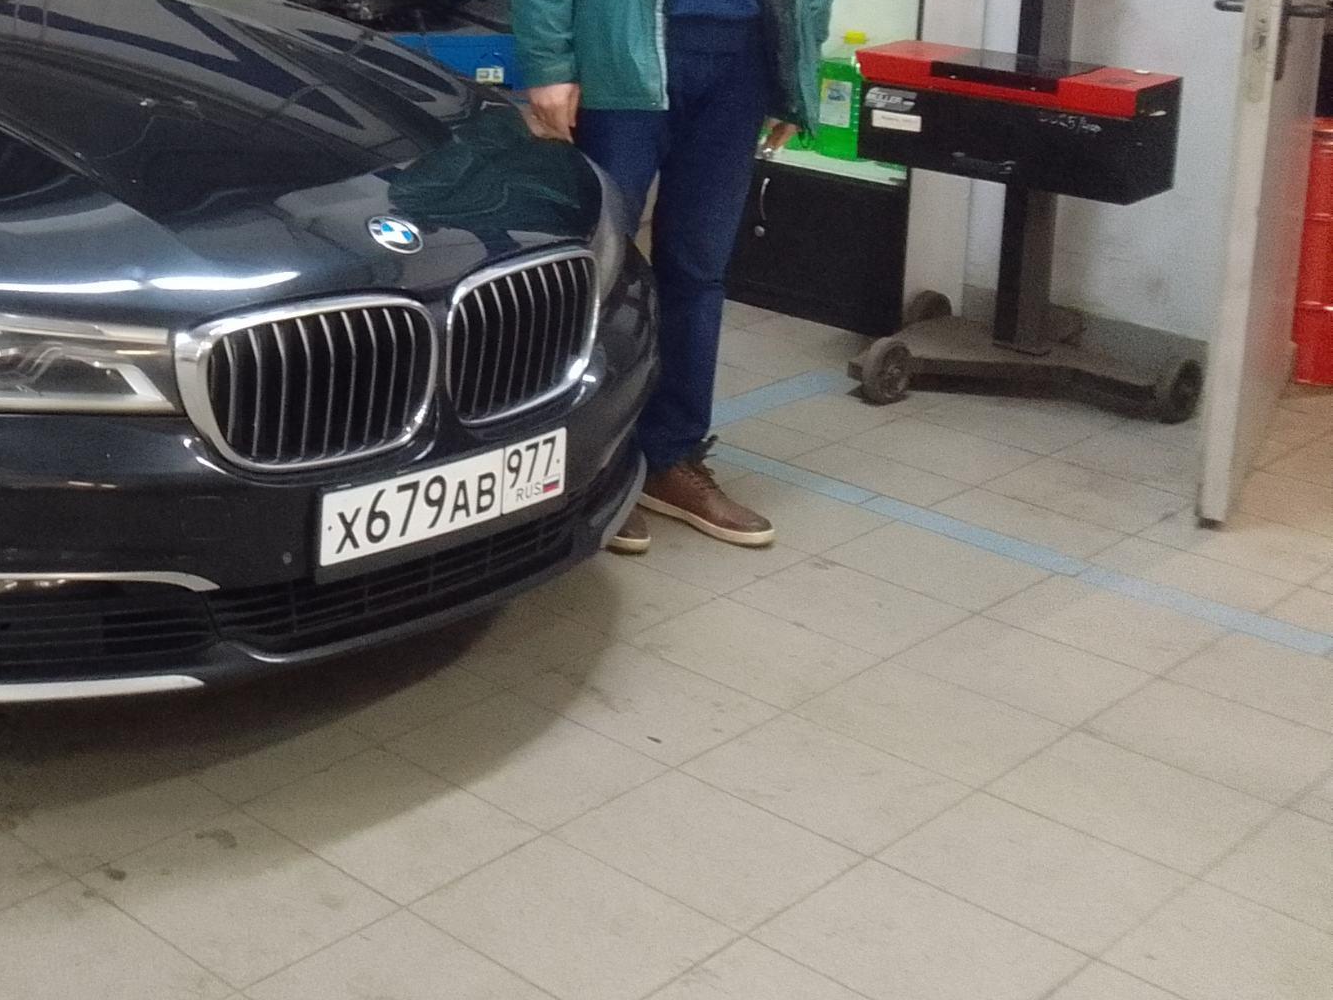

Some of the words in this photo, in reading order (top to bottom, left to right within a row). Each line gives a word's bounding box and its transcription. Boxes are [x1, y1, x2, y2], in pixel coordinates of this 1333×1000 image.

[335, 472, 496, 554] Х679АВ
[506, 435, 557, 489] 977
[516, 481, 542, 501] RUS
